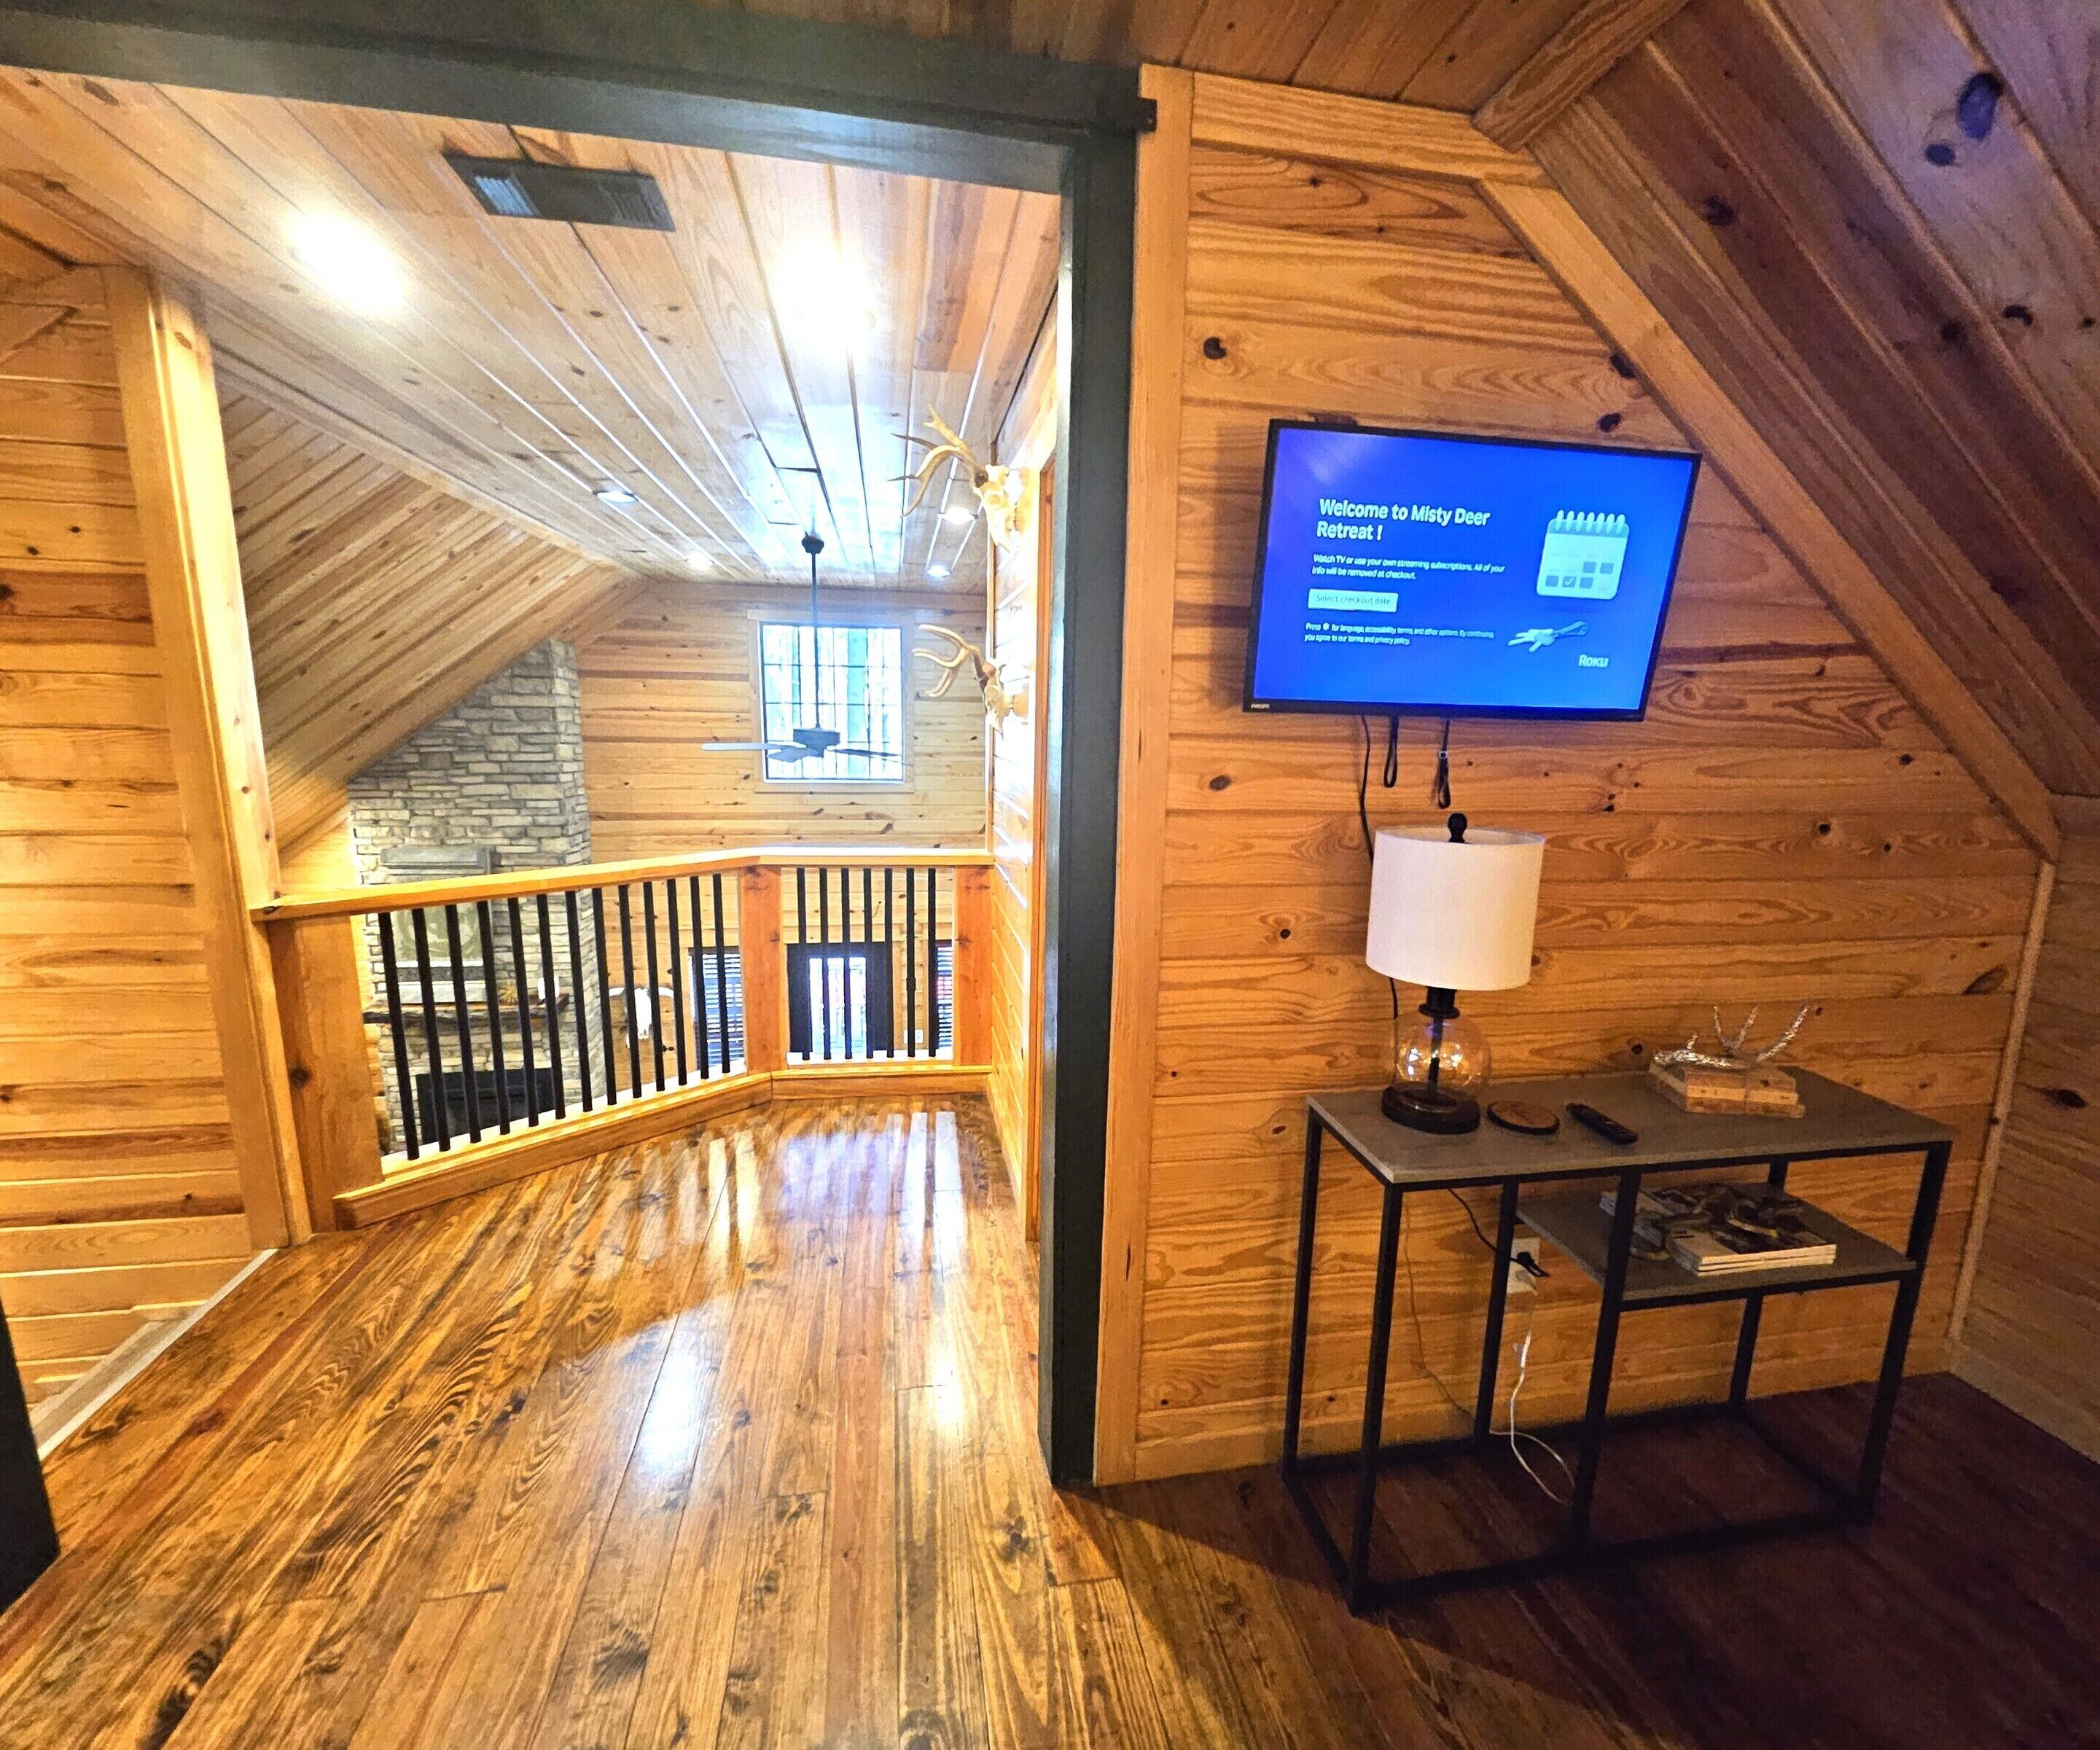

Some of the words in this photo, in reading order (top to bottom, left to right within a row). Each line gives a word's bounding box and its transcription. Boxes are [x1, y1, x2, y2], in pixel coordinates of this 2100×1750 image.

[1319, 499, 1389, 519] Welcome
[1391, 504, 1408, 520] to
[1411, 504, 1453, 526] Misty
[1454, 507, 1491, 526] Deer
[1316, 520, 1373, 540] Retreat
[1377, 525, 1383, 541] !
[1314, 554, 1335, 563] Watch
[1336, 555, 1346, 563] TV
[1367, 558, 1382, 567] your
[1397, 560, 1429, 570] streaming
[1483, 563, 1491, 572] of
[1490, 566, 1505, 574] your
[1312, 566, 1325, 575] info
[1327, 567, 1337, 575] will
[1338, 567, 1347, 576] be
[1347, 569, 1378, 577] removed
[1386, 571, 1416, 579] checkout.
[1316, 595, 1338, 603] Select
[1340, 596, 1373, 604] checkout
[1375, 597, 1391, 605] date
[1578, 655, 1609, 668] Roku
